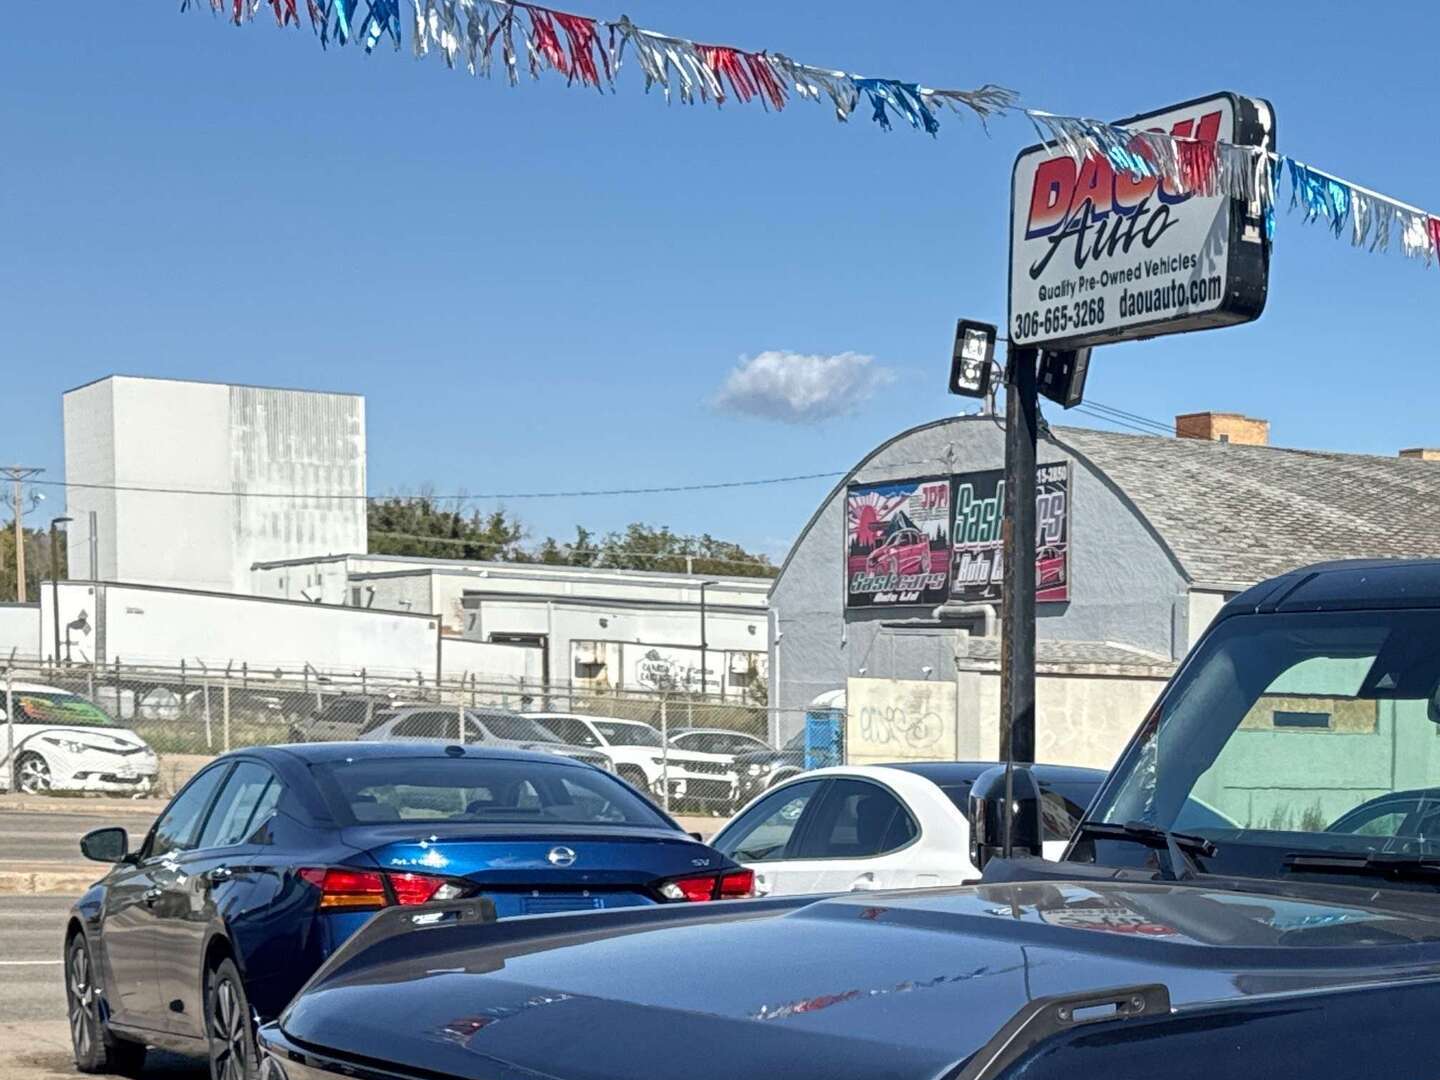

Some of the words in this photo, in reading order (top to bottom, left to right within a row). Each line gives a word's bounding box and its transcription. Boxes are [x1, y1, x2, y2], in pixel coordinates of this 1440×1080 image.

[1029, 195, 1179, 280] Auto
[1014, 296, 1106, 340] 306-665-3268
[1118, 275, 1222, 318] daouauto.com
[1038, 279, 1077, 302] Quality
[1078, 261, 1142, 293] Pre-Owned
[1144, 252, 1198, 278] Vehicles
